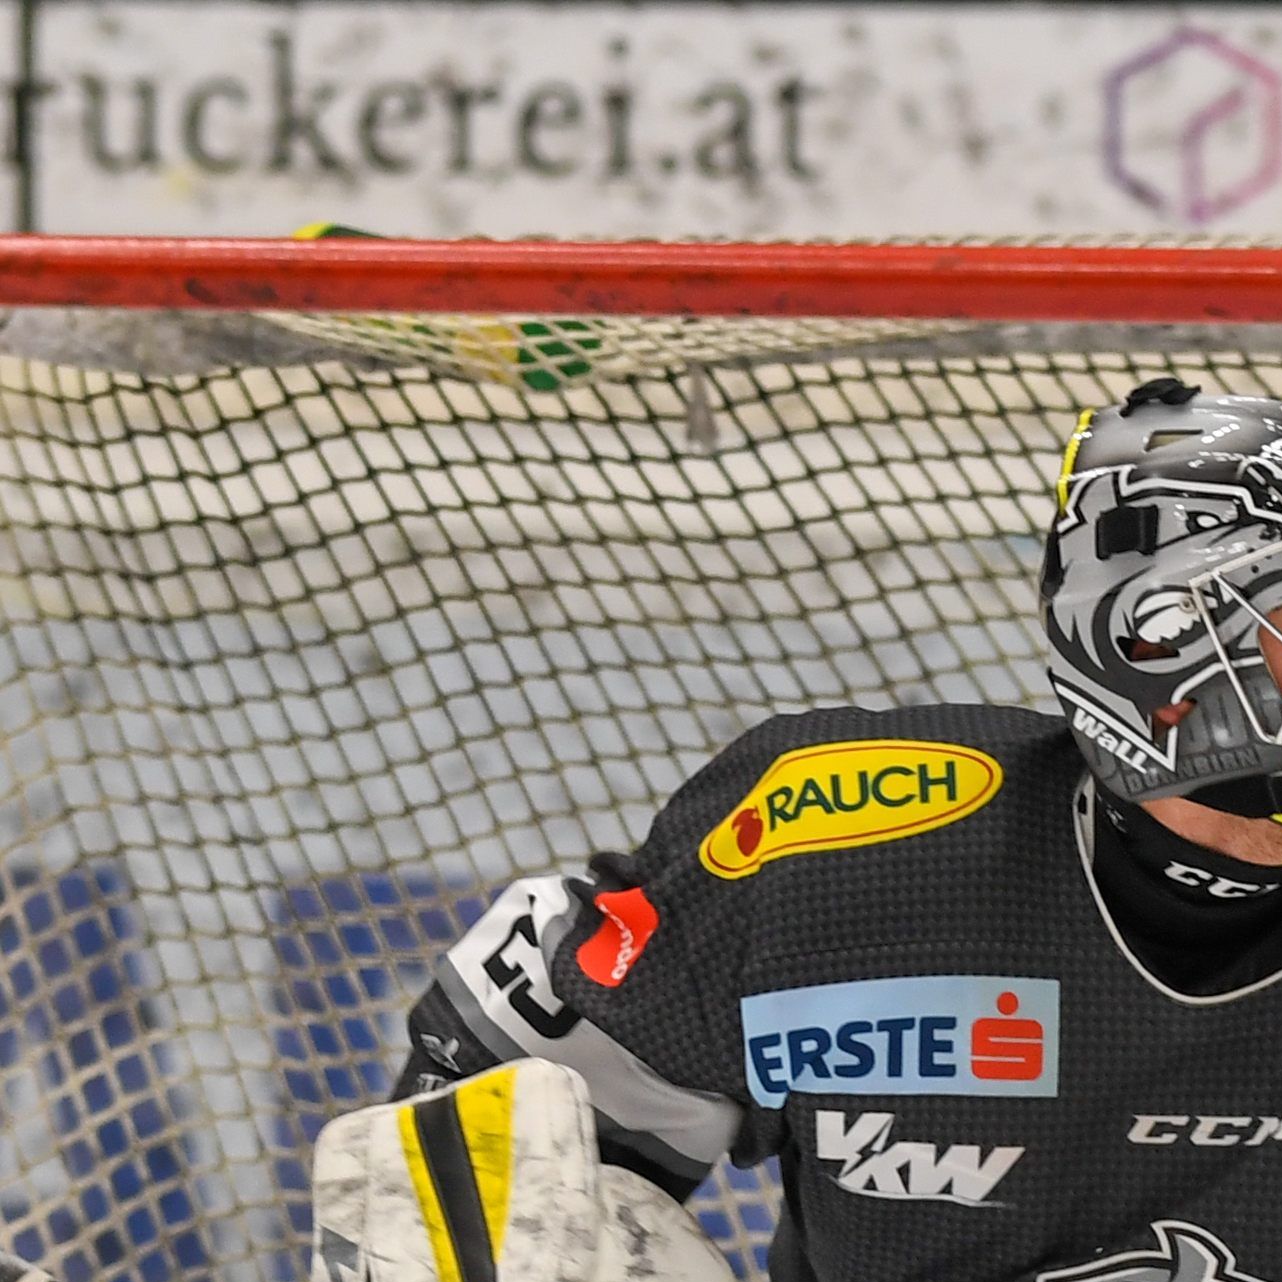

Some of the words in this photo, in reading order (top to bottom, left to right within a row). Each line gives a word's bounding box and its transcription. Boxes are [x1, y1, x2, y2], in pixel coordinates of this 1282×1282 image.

[766, 760, 957, 832] RAUCH
[1163, 860, 1282, 899] CC
[750, 1016, 958, 1094] ERSTE
